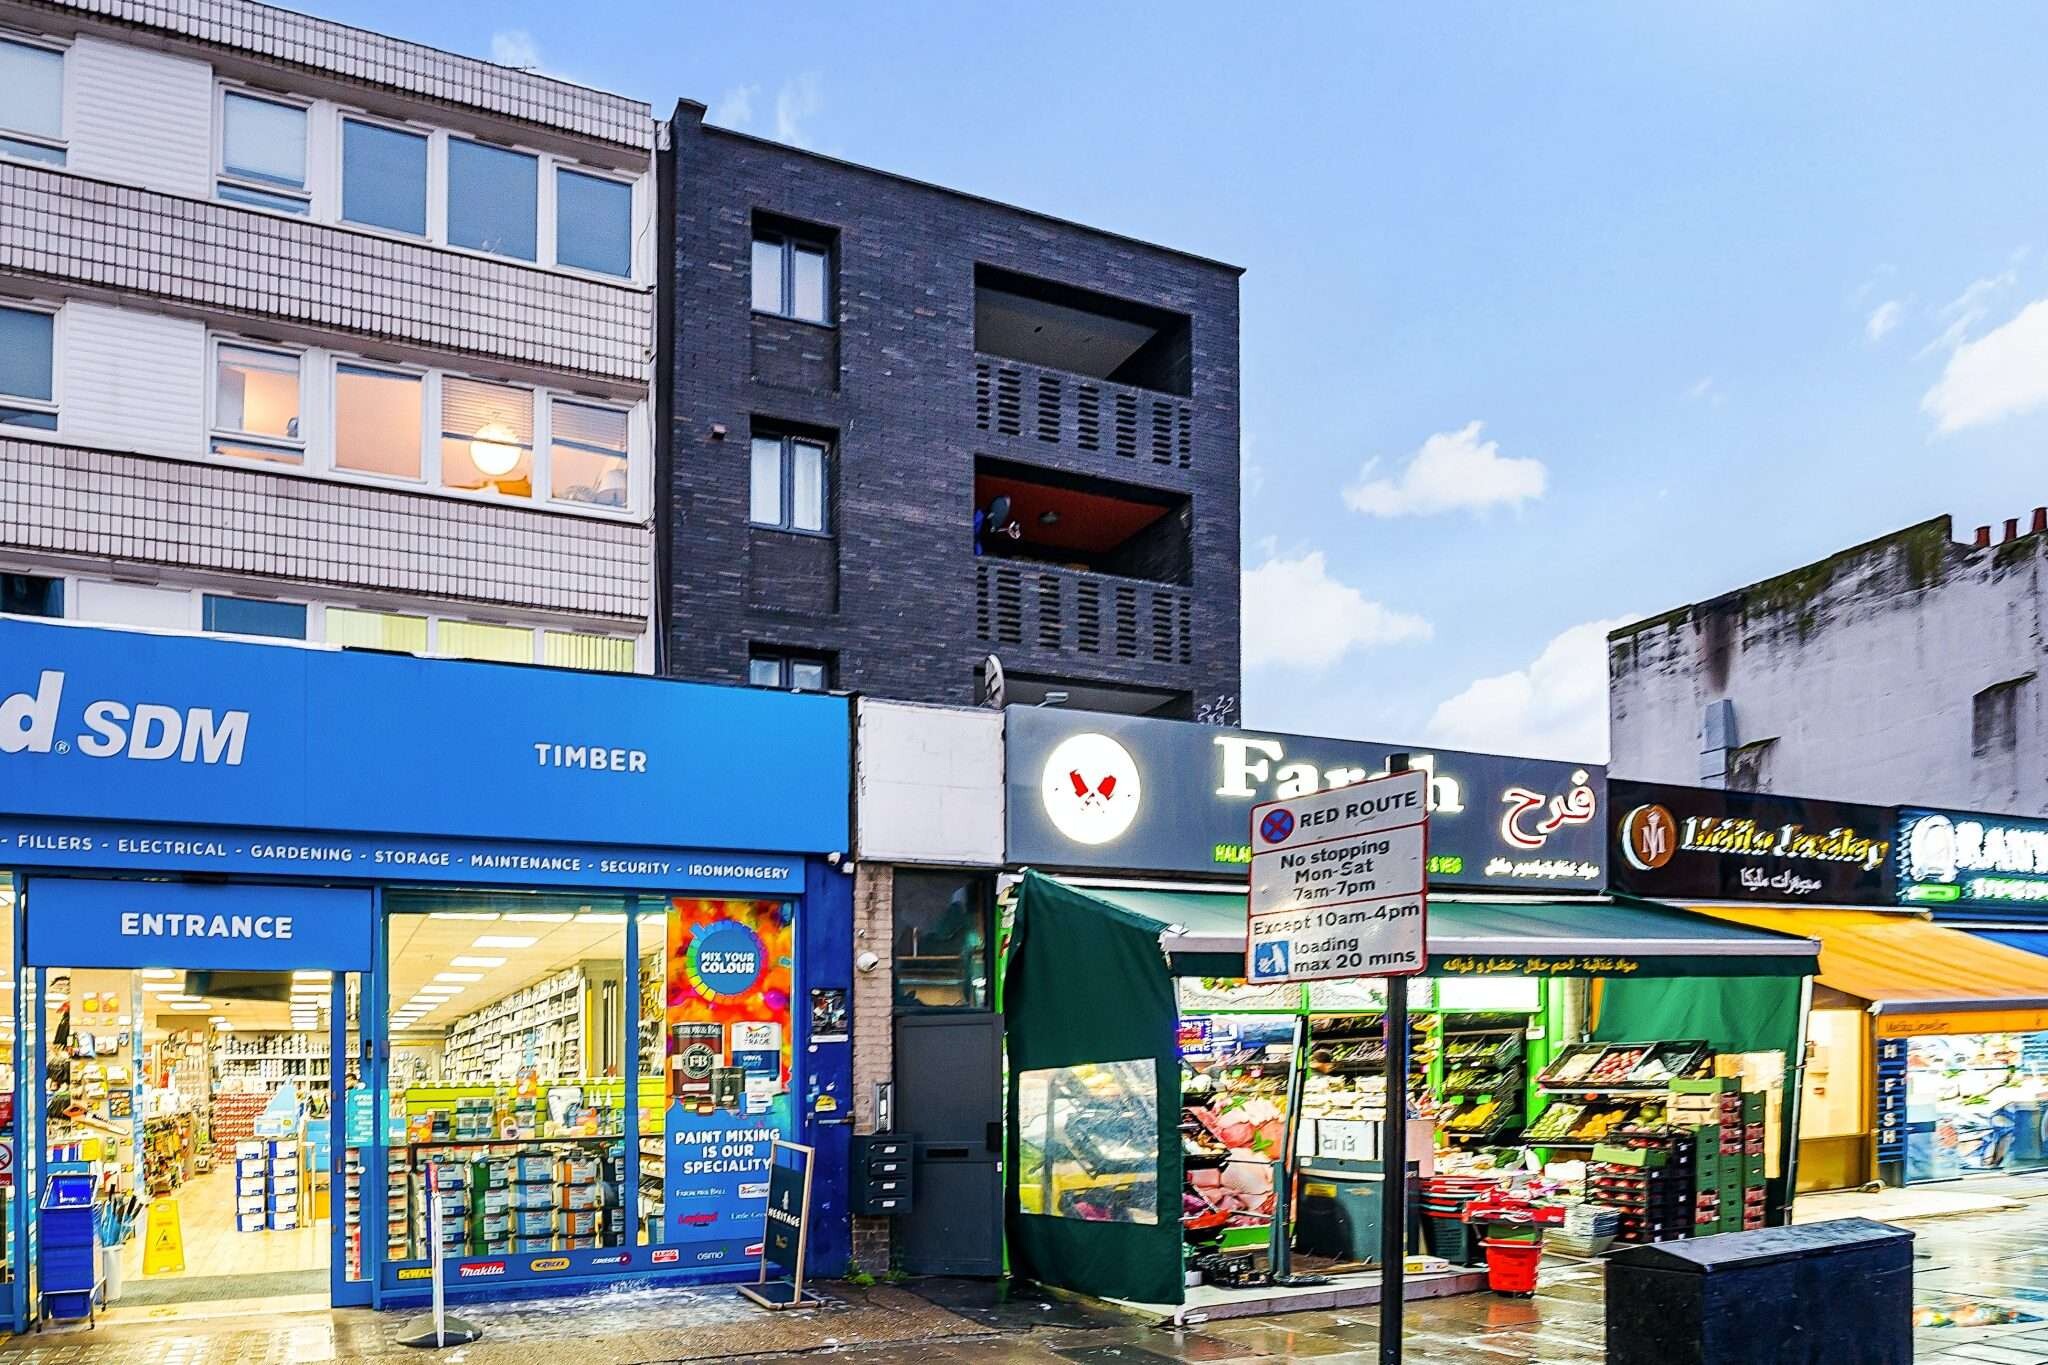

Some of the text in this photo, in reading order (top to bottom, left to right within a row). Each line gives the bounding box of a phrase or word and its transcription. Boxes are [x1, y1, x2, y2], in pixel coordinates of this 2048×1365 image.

[77, 700, 249, 765] SDM
[534, 743, 648, 773] TIMBER
[1300, 791, 1417, 828] RED ROUTE
[1502, 769, 1596, 849] فرح
[18, 834, 790, 880] FILLERS ELECTRICAL GARDENING STORAGE MAINTENANCE SECURITY IRONMONGERY
[1280, 840, 1390, 869] No stopping
[1295, 858, 1375, 884] Mon-Sat
[1293, 880, 1375, 901] 7am-7pm
[120, 912, 293, 939] ENTRANCE
[1254, 904, 1420, 936] Except 10am-4pm
[701, 952, 755, 962] MIX YOUR
[1294, 937, 1359, 955] loading
[701, 962, 755, 974] COLOUR
[1293, 951, 1416, 973] max 20 mins
[1883, 1077, 1897, 1144] FISH
[675, 1128, 780, 1145] PAINT MIXING
[702, 1144, 754, 1159] IS OUR
[683, 1158, 772, 1175] SPECIALITY
